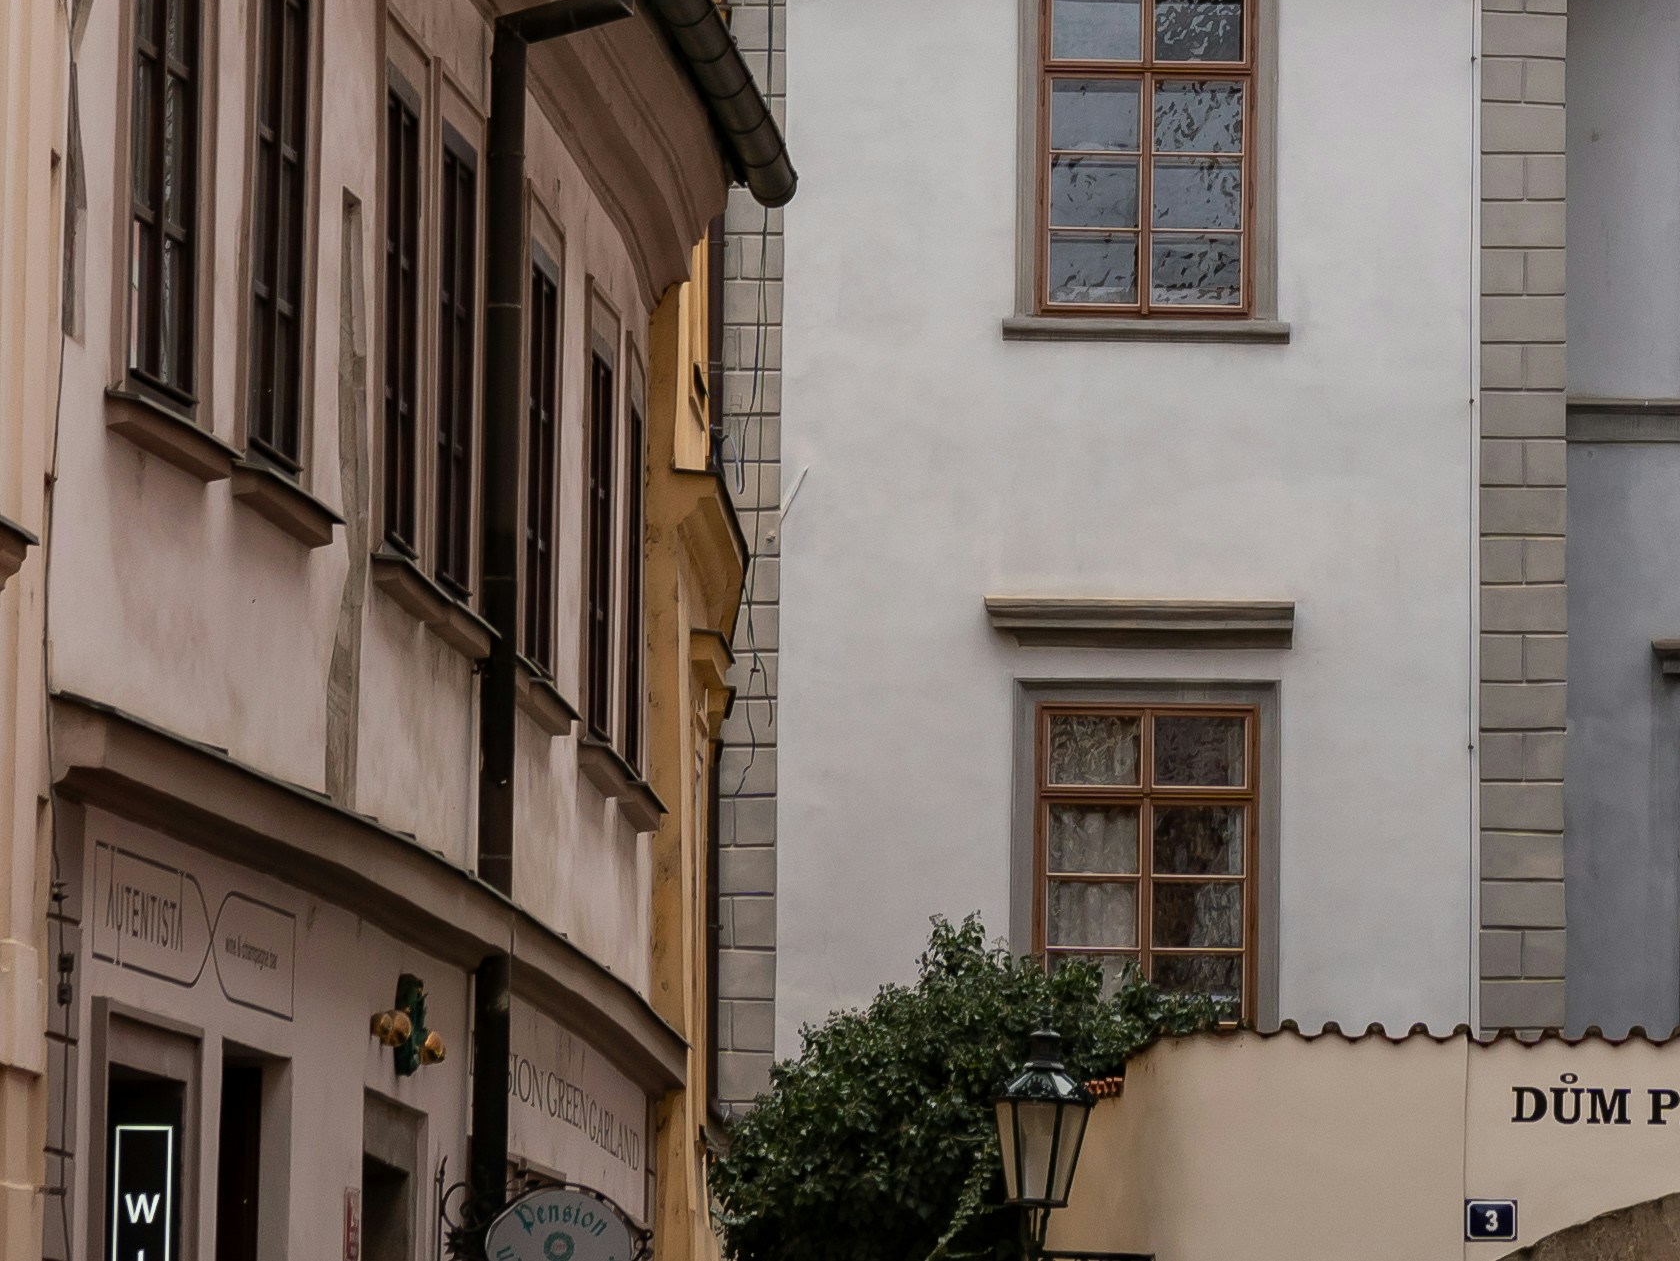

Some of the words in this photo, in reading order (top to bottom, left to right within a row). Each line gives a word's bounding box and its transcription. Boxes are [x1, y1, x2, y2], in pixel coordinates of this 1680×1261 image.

[106, 847, 184, 961] AUTENTISTA
[546, 1071, 590, 1133] GREEN
[588, 1100, 640, 1171] GARLAND
[1511, 1072, 1632, 1125] DŮM
[514, 1202, 608, 1236] Pension
[1485, 1210, 1498, 1231] 3
